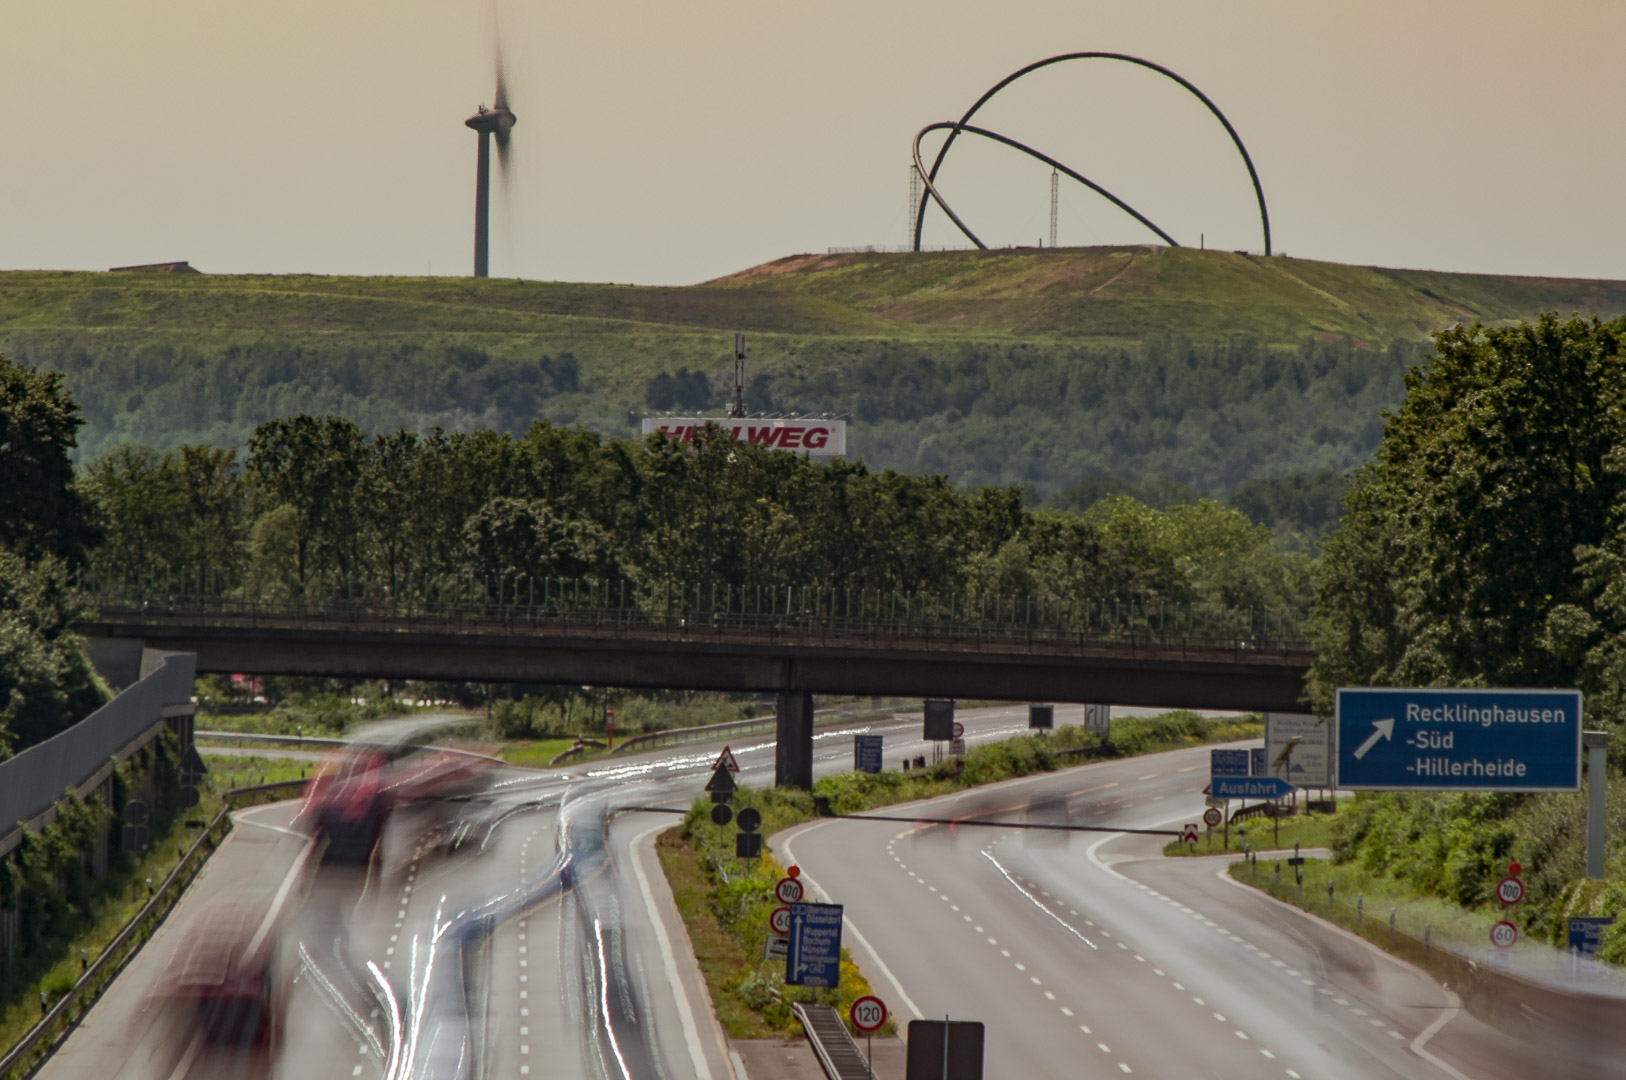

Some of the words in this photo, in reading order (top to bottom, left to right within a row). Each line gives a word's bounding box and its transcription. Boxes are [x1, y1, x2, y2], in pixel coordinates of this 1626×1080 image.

[1406, 703, 1565, 728] Recklinghausen
[1406, 730, 1454, 749] -Süd
[1406, 757, 1527, 777] -Hillerheide
[1219, 781, 1278, 795] Ausfahrt
[782, 884, 799, 899] 100
[1502, 884, 1519, 899] 100
[803, 927, 838, 937] Wuppertal
[1495, 928, 1512, 941] 60
[802, 936, 831, 946] Bochum
[801, 945, 830, 955] Münster
[858, 1006, 880, 1022] 120
